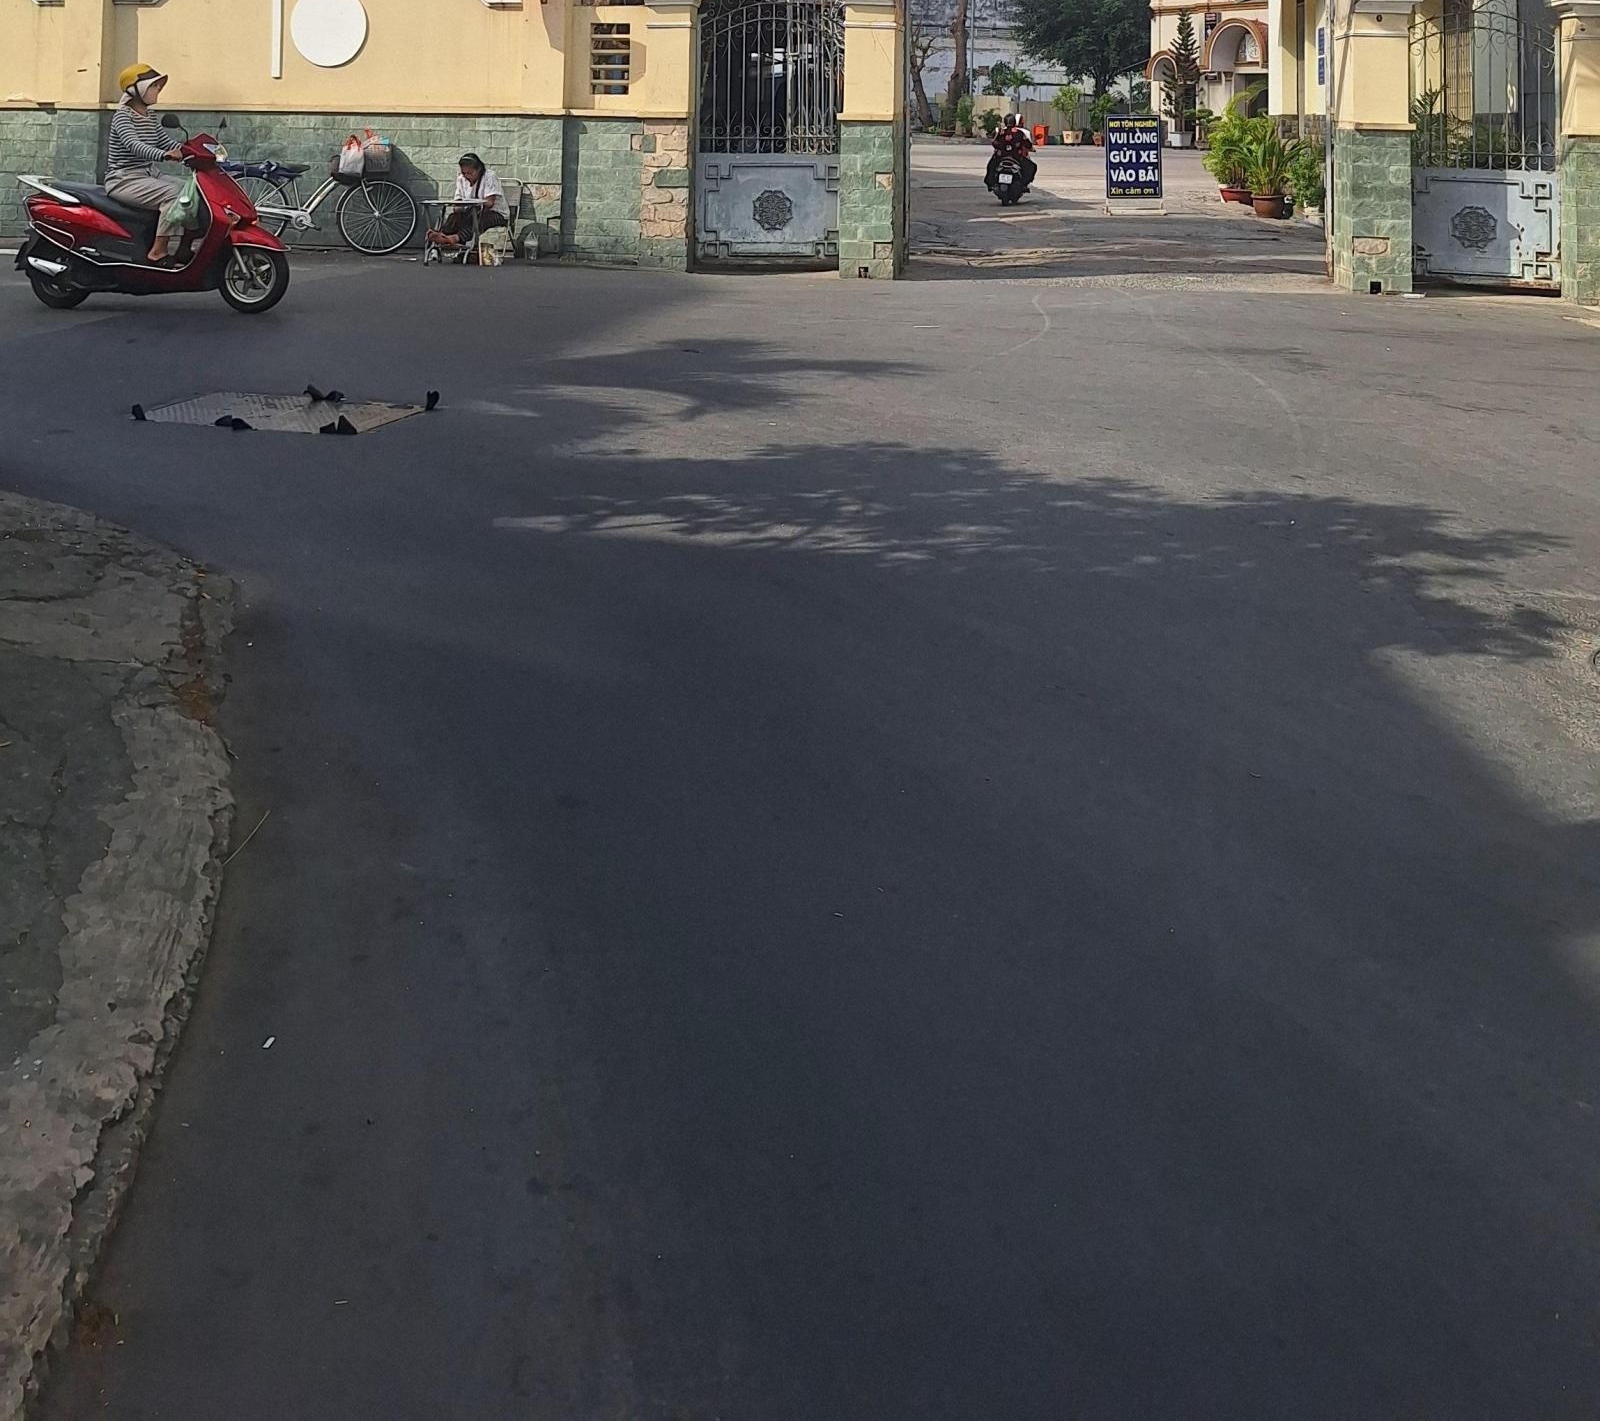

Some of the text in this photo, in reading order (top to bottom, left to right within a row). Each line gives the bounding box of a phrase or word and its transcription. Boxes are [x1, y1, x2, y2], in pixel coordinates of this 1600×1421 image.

[1109, 128, 1158, 144] VUI LÒNG
[1109, 147, 1158, 163] GỬI XE
[1110, 165, 1159, 182] VÀO BÃI
